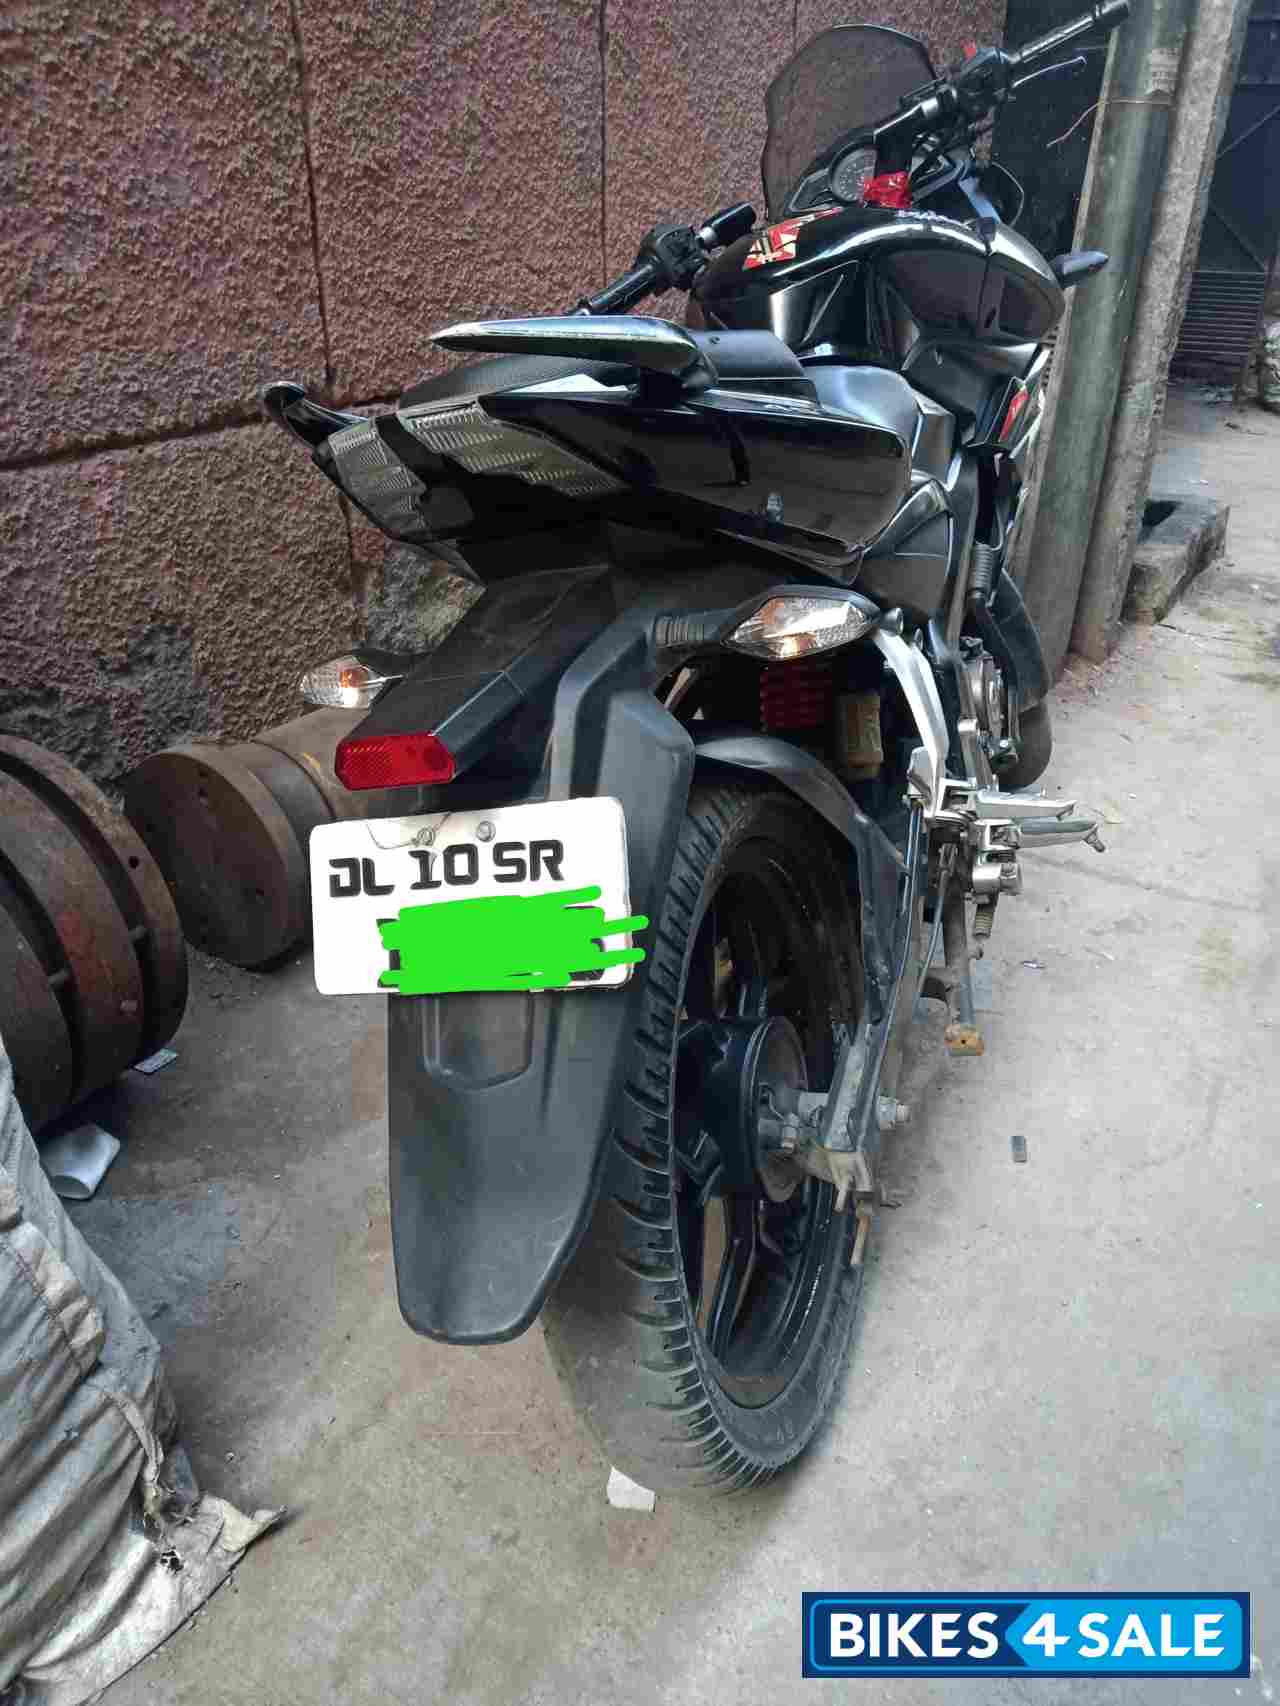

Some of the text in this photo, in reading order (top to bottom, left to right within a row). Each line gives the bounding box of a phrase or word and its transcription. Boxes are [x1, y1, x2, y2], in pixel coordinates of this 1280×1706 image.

[329, 839, 565, 898] DL 10 SR
